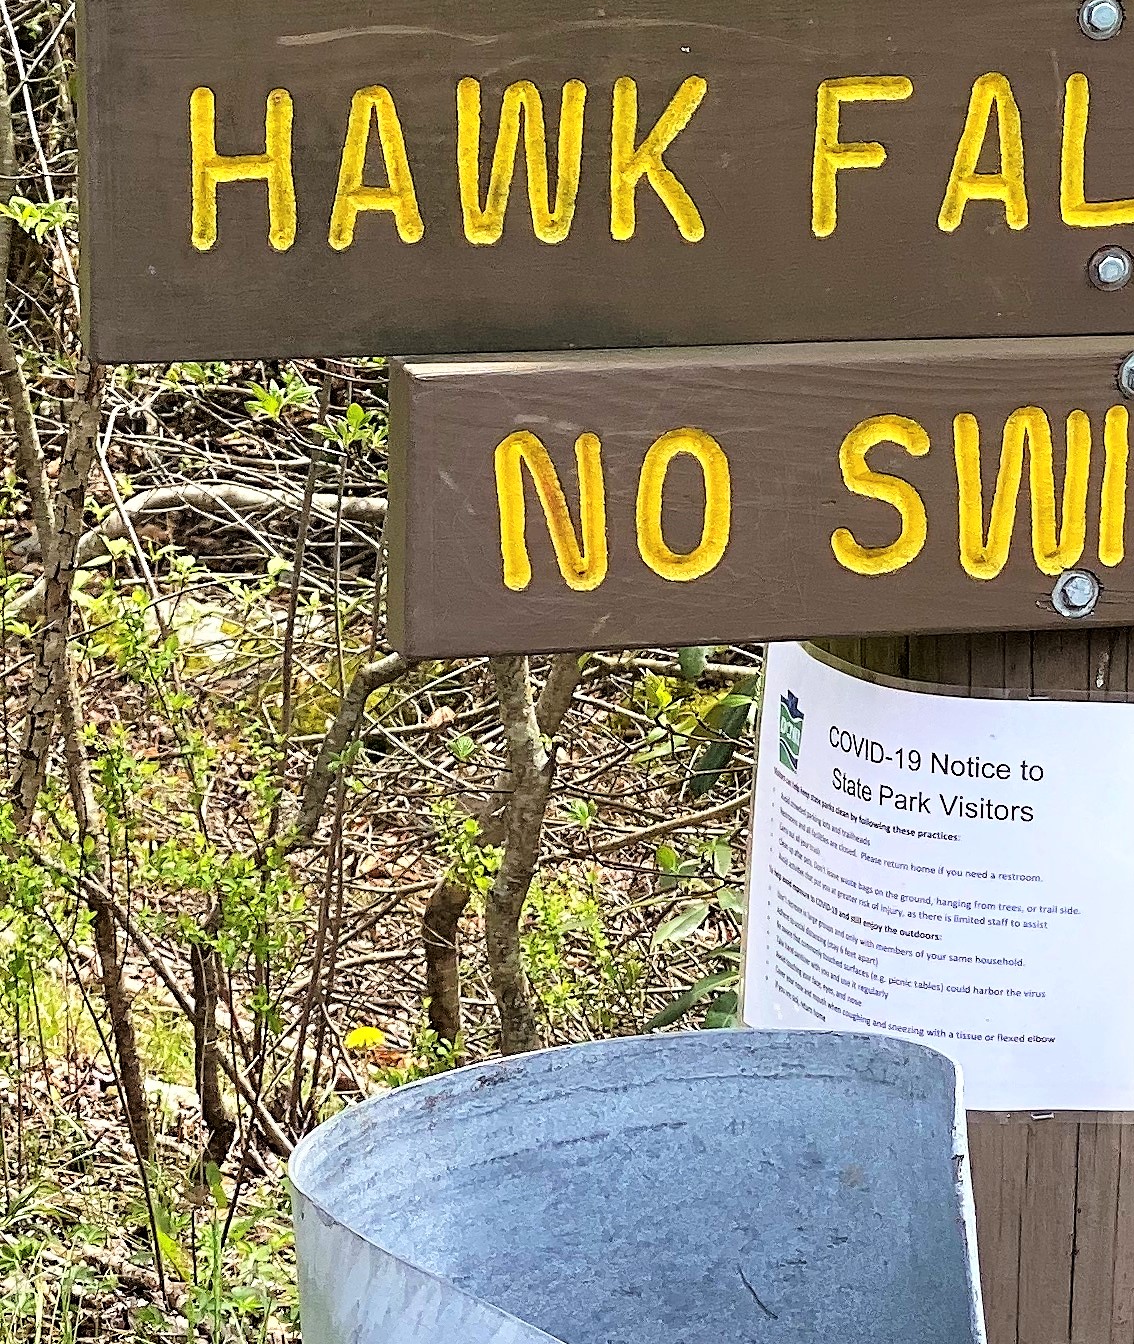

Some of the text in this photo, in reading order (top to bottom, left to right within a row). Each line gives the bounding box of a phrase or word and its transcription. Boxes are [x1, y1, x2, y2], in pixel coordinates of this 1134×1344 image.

[189, 75, 709, 251] HAWK
[493, 428, 732, 591] NO
[829, 725, 1044, 782] COVID-19 Notice to
[832, 767, 1034, 822] State Park Visitors
[892, 824, 915, 835] these
[883, 859, 908, 869] return
[910, 863, 935, 873] home
[937, 866, 944, 874] if
[946, 869, 962, 877] you
[965, 870, 987, 878] need
[998, 872, 1043, 881] restroom.
[935, 897, 971, 909] hanging
[974, 901, 995, 910] from
[998, 902, 1024, 912] trees,
[1039, 905, 1057, 913] trail
[1059, 906, 1081, 914] side.
[918, 910, 942, 920] there
[944, 913, 951, 921] is
[953, 914, 985, 924] limited
[987, 918, 1008, 926] staff
[1022, 920, 1048, 928] assist
[925, 952, 946, 960] your
[888, 976, 911, 986] picnic
[913, 980, 943, 992] tables)
[946, 985, 970, 993] could
[972, 986, 1004, 995] harbor
[1006, 988, 1021, 996] the
[1023, 989, 1046, 997] virus
[887, 1023, 925, 1036] sneezing
[926, 1028, 945, 1037] with
[955, 1030, 982, 1040] tissue
[997, 1033, 1025, 1042] flexed
[1027, 1035, 1056, 1043] elbow
